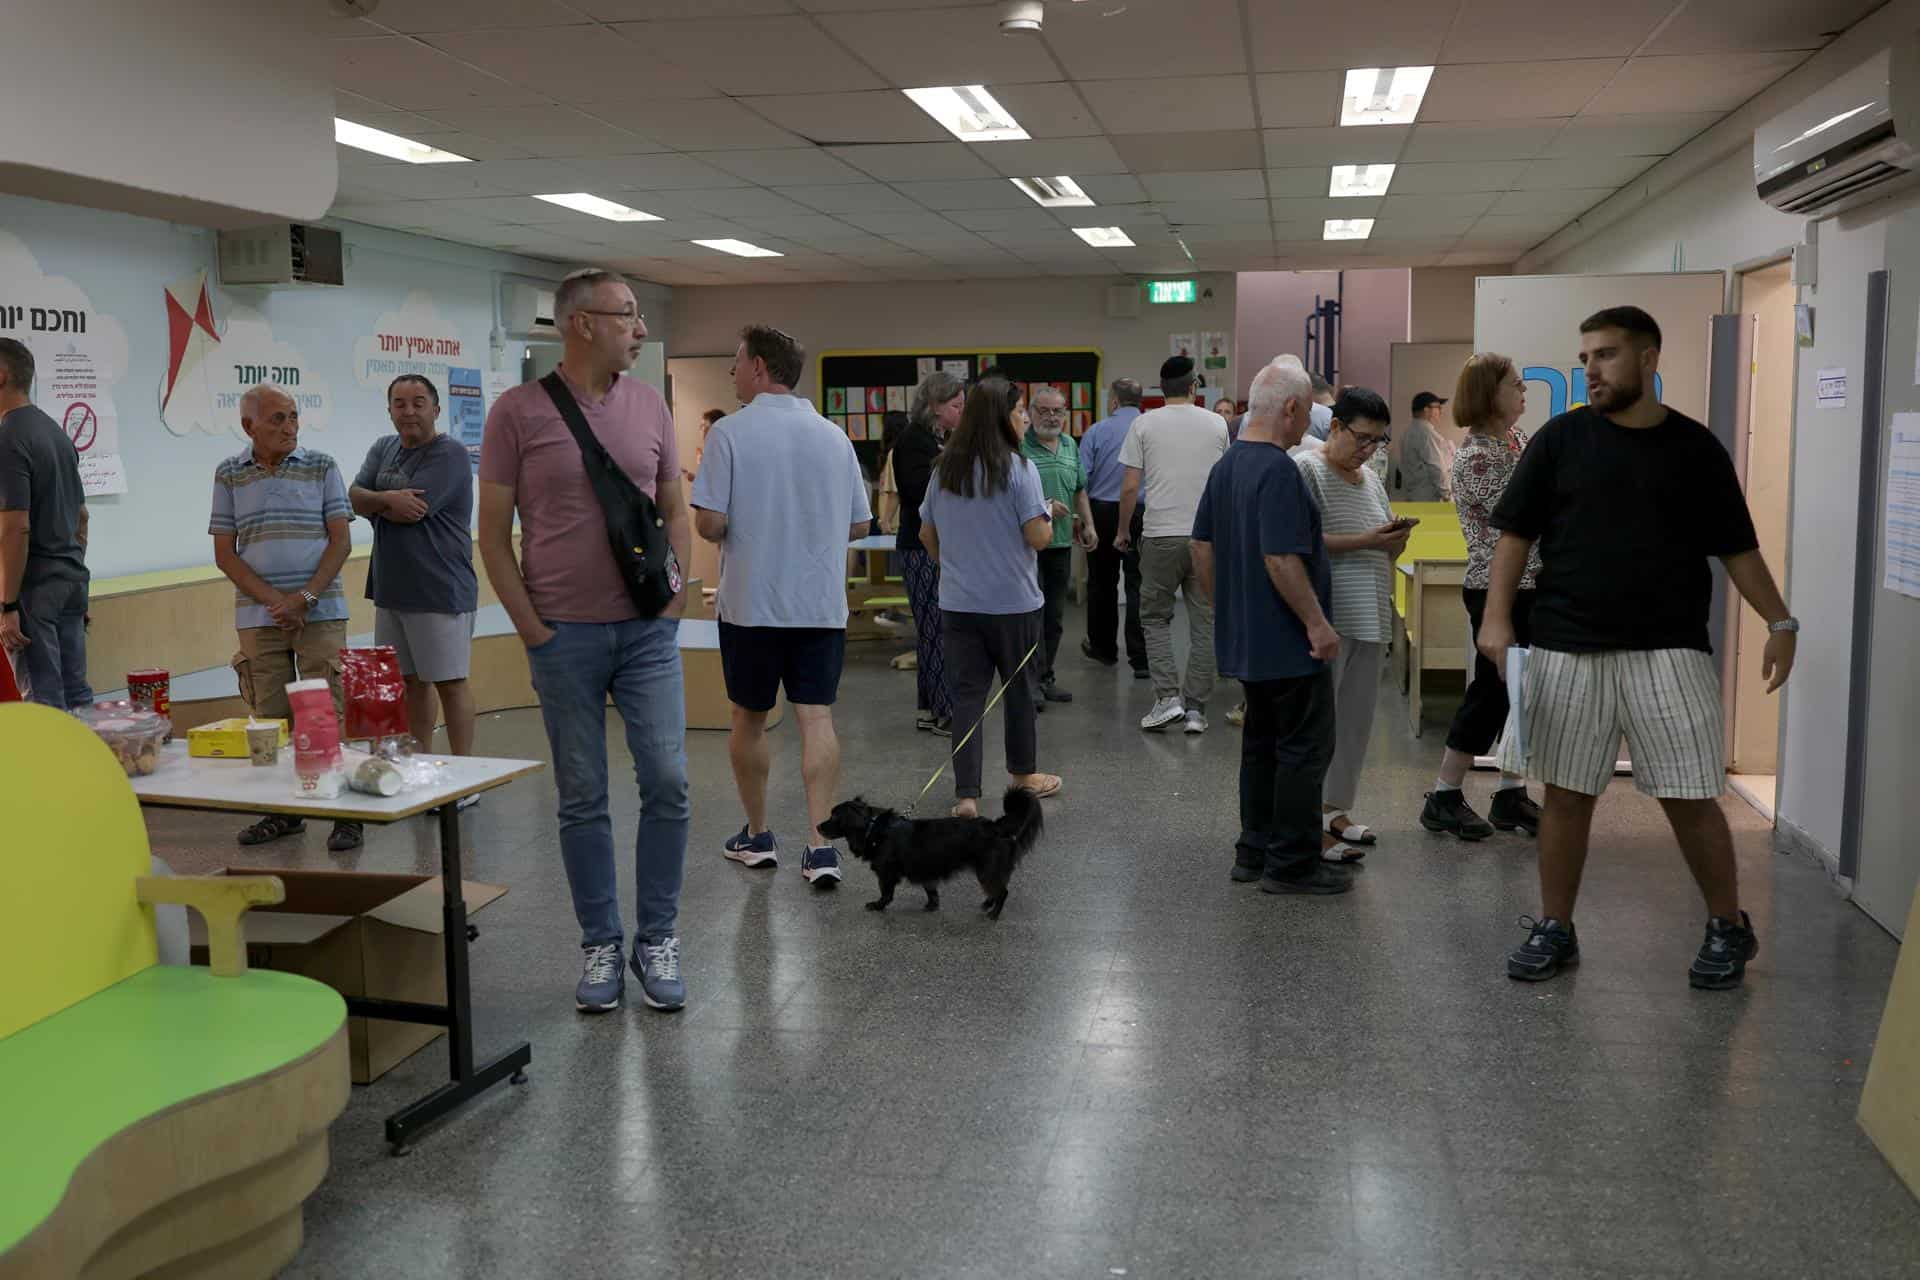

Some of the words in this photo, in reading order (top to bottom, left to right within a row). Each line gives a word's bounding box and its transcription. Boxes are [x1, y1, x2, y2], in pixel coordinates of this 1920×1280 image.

[1154, 281, 1191, 303] יציאה
[30, 308, 86, 333] וחכם
[377, 334, 402, 352] יותר
[406, 336, 434, 359] אמיץ
[436, 339, 460, 356] אתה
[234, 365, 267, 384] יותר
